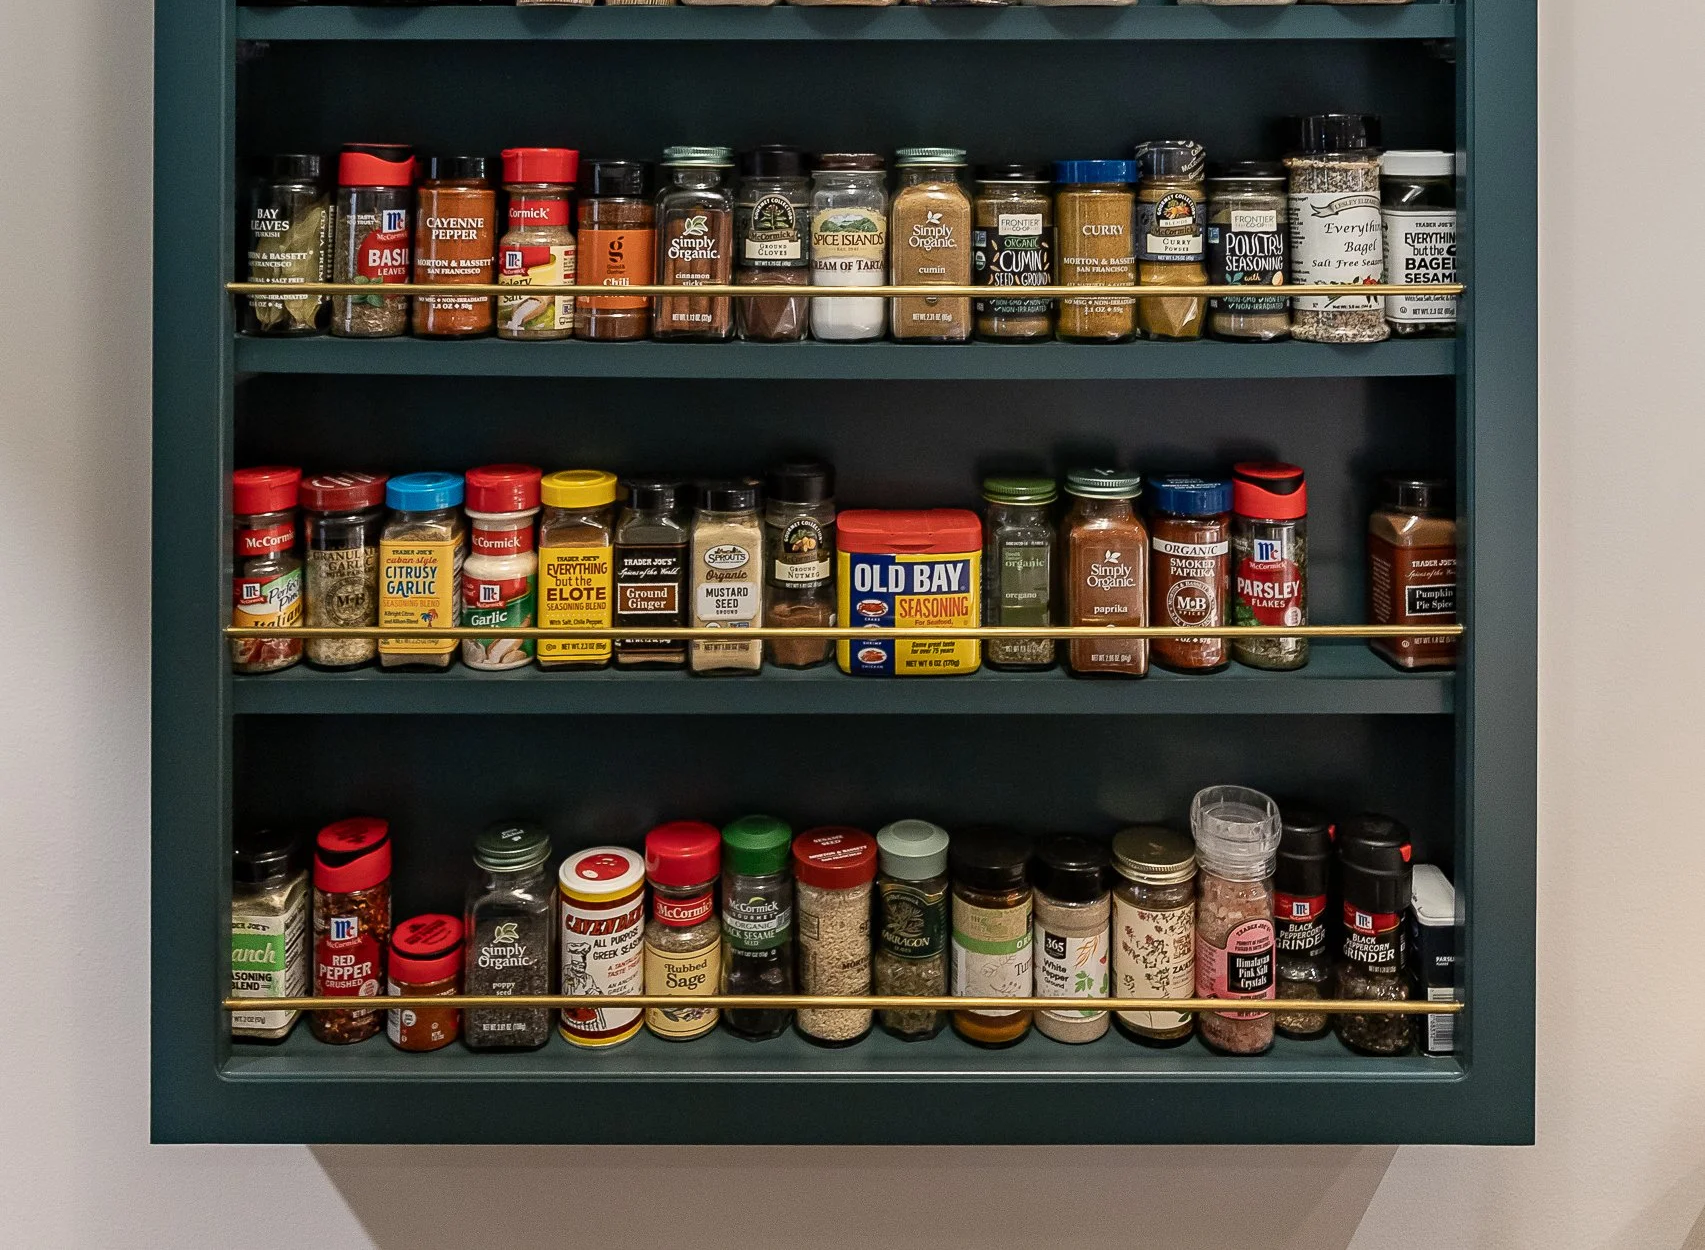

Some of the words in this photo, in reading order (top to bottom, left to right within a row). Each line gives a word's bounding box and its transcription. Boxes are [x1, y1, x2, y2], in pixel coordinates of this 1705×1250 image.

[257, 208, 280, 220] BAY
[1234, 215, 1275, 224] FRONTIER
[250, 220, 290, 232] LEAVES
[426, 217, 485, 229] CAYENNE
[1001, 219, 1040, 227] FRONTIER
[431, 229, 478, 240] PEPPER
[912, 223, 953, 239] Simply
[1082, 225, 1124, 236] CURRY
[671, 236, 715, 251] Simply
[813, 232, 839, 247] SPICE
[840, 231, 885, 247] ISLANDS
[1004, 238, 1039, 249] ORGANIC
[1162, 238, 1192, 246] CURRY
[1225, 232, 1284, 256] POULTRY
[757, 248, 788, 257] CLOVES
[1343, 238, 1378, 256] Bagel
[1412, 244, 1429, 257] but
[1429, 244, 1445, 257] the
[368, 248, 410, 267] BASIL
[999, 250, 1043, 272] CUMIN
[1225, 255, 1284, 273] SEASONING
[377, 268, 406, 276] LEAVES
[840, 261, 854, 271] OF
[918, 266, 946, 274] cumin
[1164, 543, 1219, 556] ORGANIC
[1005, 558, 1045, 571] organic
[1170, 557, 1216, 569] SMOKED
[385, 565, 438, 581] CITRUSY
[546, 562, 608, 579] EVERYTHING
[705, 569, 749, 583] Organic
[854, 563, 906, 593] OLD
[913, 562, 965, 593] BAY
[1090, 563, 1133, 579] Simply
[1170, 566, 1216, 578] PAPRIKA
[555, 576, 574, 589] but
[575, 575, 593, 587] the
[1237, 578, 1301, 600] PARSLEY
[386, 580, 436, 599] GARLIC
[546, 586, 607, 602] ELOTE
[626, 587, 668, 599] Ground
[705, 587, 749, 598] MUSTARD
[1005, 591, 1038, 600] oregano
[1415, 588, 1454, 600] Pumpkin
[628, 599, 667, 611] Ginger
[714, 597, 740, 609] SEED
[899, 596, 969, 619] SEASONING
[1251, 598, 1286, 609] FLAKES
[1093, 605, 1129, 616] paprika
[471, 611, 508, 627] Garlic
[729, 900, 779, 913] McCormick
[735, 922, 772, 931] ORGANIC
[1279, 924, 1324, 940] PEPPERCORN
[1289, 921, 1314, 933] BLACK
[593, 937, 607, 950] ALL
[609, 928, 640, 945] PURPOSE
[743, 929, 776, 942] SESAME
[1275, 930, 1327, 951] GRINDER
[1352, 933, 1377, 945] BLACK
[1045, 936, 1065, 953] 365
[1345, 937, 1391, 953] PEPPERCORN
[481, 943, 527, 962] Simply
[592, 947, 619, 961] GREEK
[1343, 947, 1396, 964] GRINDER
[332, 955, 356, 966] RED
[664, 959, 708, 974] Rubbed
[1043, 958, 1068, 974] White
[1235, 953, 1271, 969] Himalayan
[319, 961, 372, 981] PEPPER
[1041, 966, 1070, 984] Pepper
[325, 978, 364, 989] CRUSHED
[665, 972, 707, 991] Sage
[1043, 976, 1066, 990] Ground
[1240, 975, 1268, 991] Crystals
